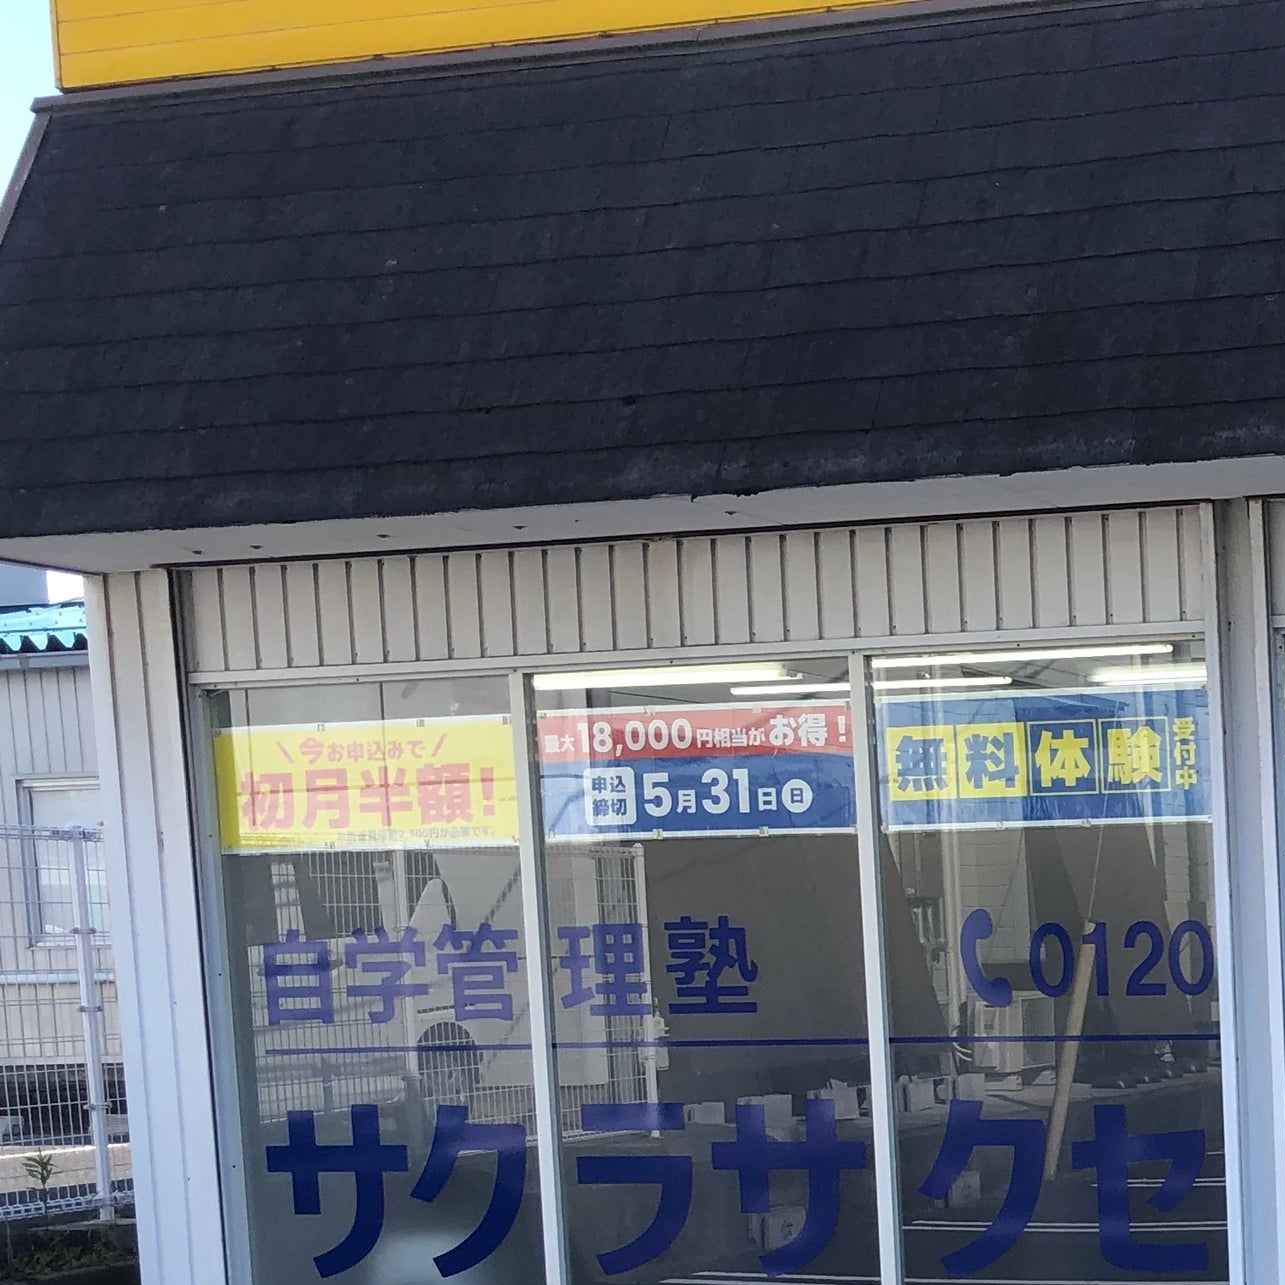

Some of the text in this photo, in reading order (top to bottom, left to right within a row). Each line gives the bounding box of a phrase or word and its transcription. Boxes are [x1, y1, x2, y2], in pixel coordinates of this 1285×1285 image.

[299, 737, 425, 764] 今お申込みで
[895, 726, 1163, 792] 無料体験
[1173, 717, 1197, 790] 受付中
[241, 763, 496, 830] 初月半額!
[591, 775, 627, 794] 申込
[591, 797, 628, 817] 締切
[643, 768, 778, 817] 5月31日
[264, 916, 759, 1026] 自学管理塾
